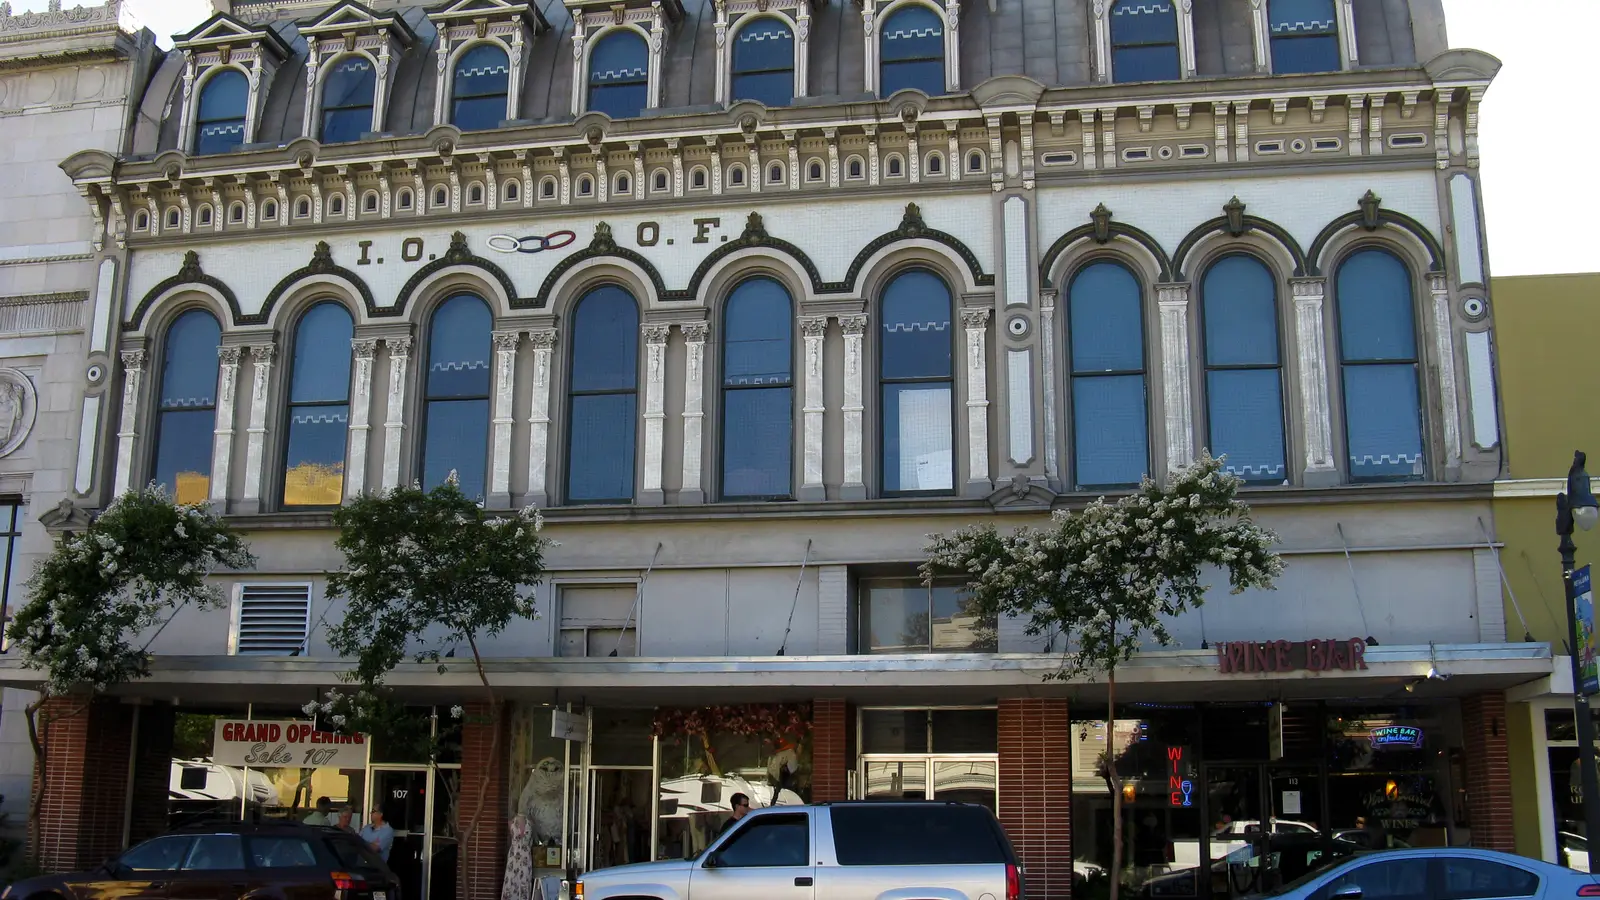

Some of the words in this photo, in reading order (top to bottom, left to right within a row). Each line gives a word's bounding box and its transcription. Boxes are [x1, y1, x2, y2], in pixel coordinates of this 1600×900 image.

[1215, 640, 1295, 673] WINE
[1305, 637, 1369, 671] BAR
[222, 723, 281, 743] GRAND
[1375, 727, 1398, 736] WINE
[1400, 727, 1417, 736] BAR
[303, 748, 338, 765] 107
[1167, 747, 1183, 806] WINE
[1288, 777, 1299, 785] 113
[392, 789, 409, 799] 107
